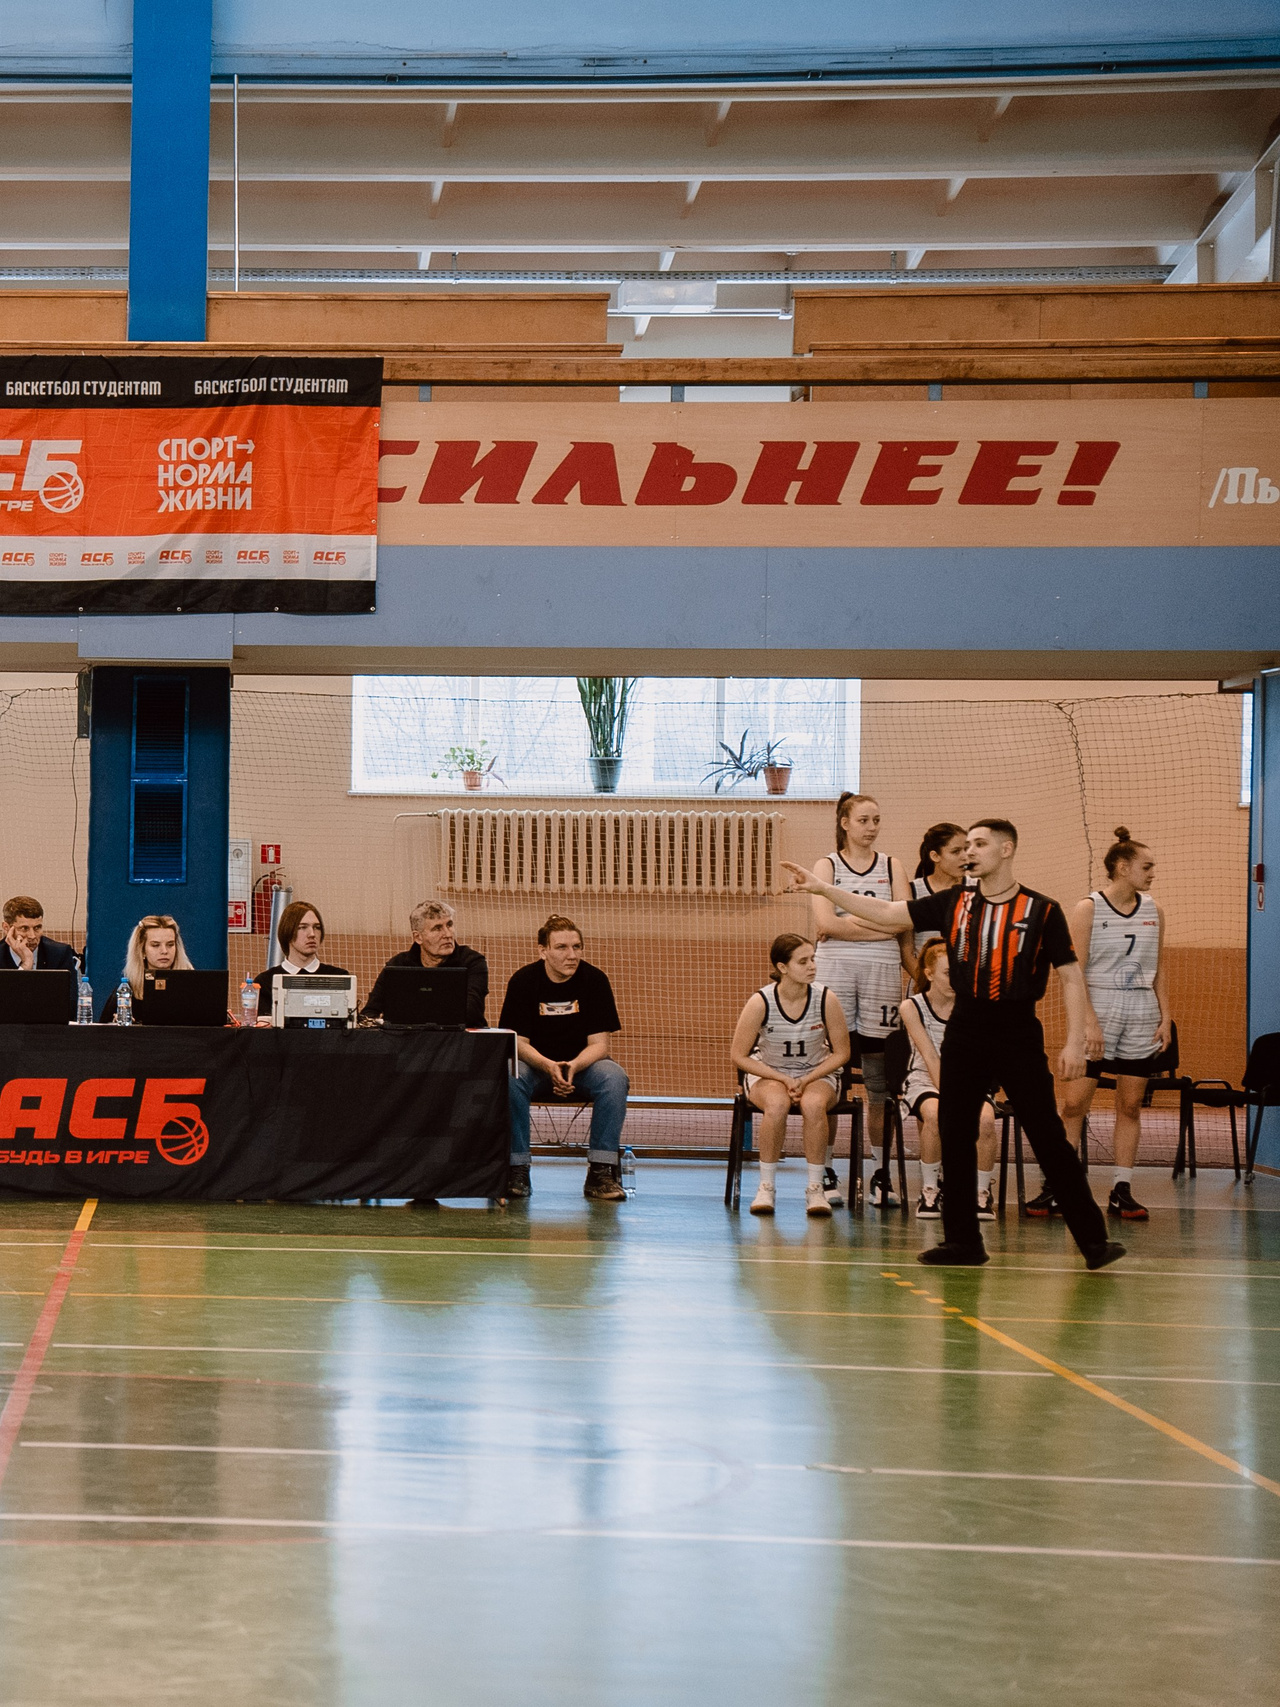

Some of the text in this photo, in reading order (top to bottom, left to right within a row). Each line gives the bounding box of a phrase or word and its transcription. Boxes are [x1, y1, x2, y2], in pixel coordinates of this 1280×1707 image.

[6, 381, 161, 397] БАСКЕТБОЛ СТУДЕНТАМ
[195, 378, 348, 394] БАСКЕТБОЛ СТУДЕНТАМ
[158, 436, 238, 461] СПОРТ
[158, 461, 252, 487] НОРМА
[158, 485, 251, 512] ЖИЗНИ
[1, 551, 36, 566] АСБ
[80, 552, 115, 566] АСБ
[158, 549, 193, 564] АСБ
[236, 549, 271, 564] АСБ
[312, 550, 347, 565] АСБ
[1125, 934, 1136, 956] 7
[880, 1005, 898, 1027] 12
[783, 1041, 807, 1057] 11
[65, 1151, 82, 1163] В
[87, 1151, 149, 1163] ИГРЕ
